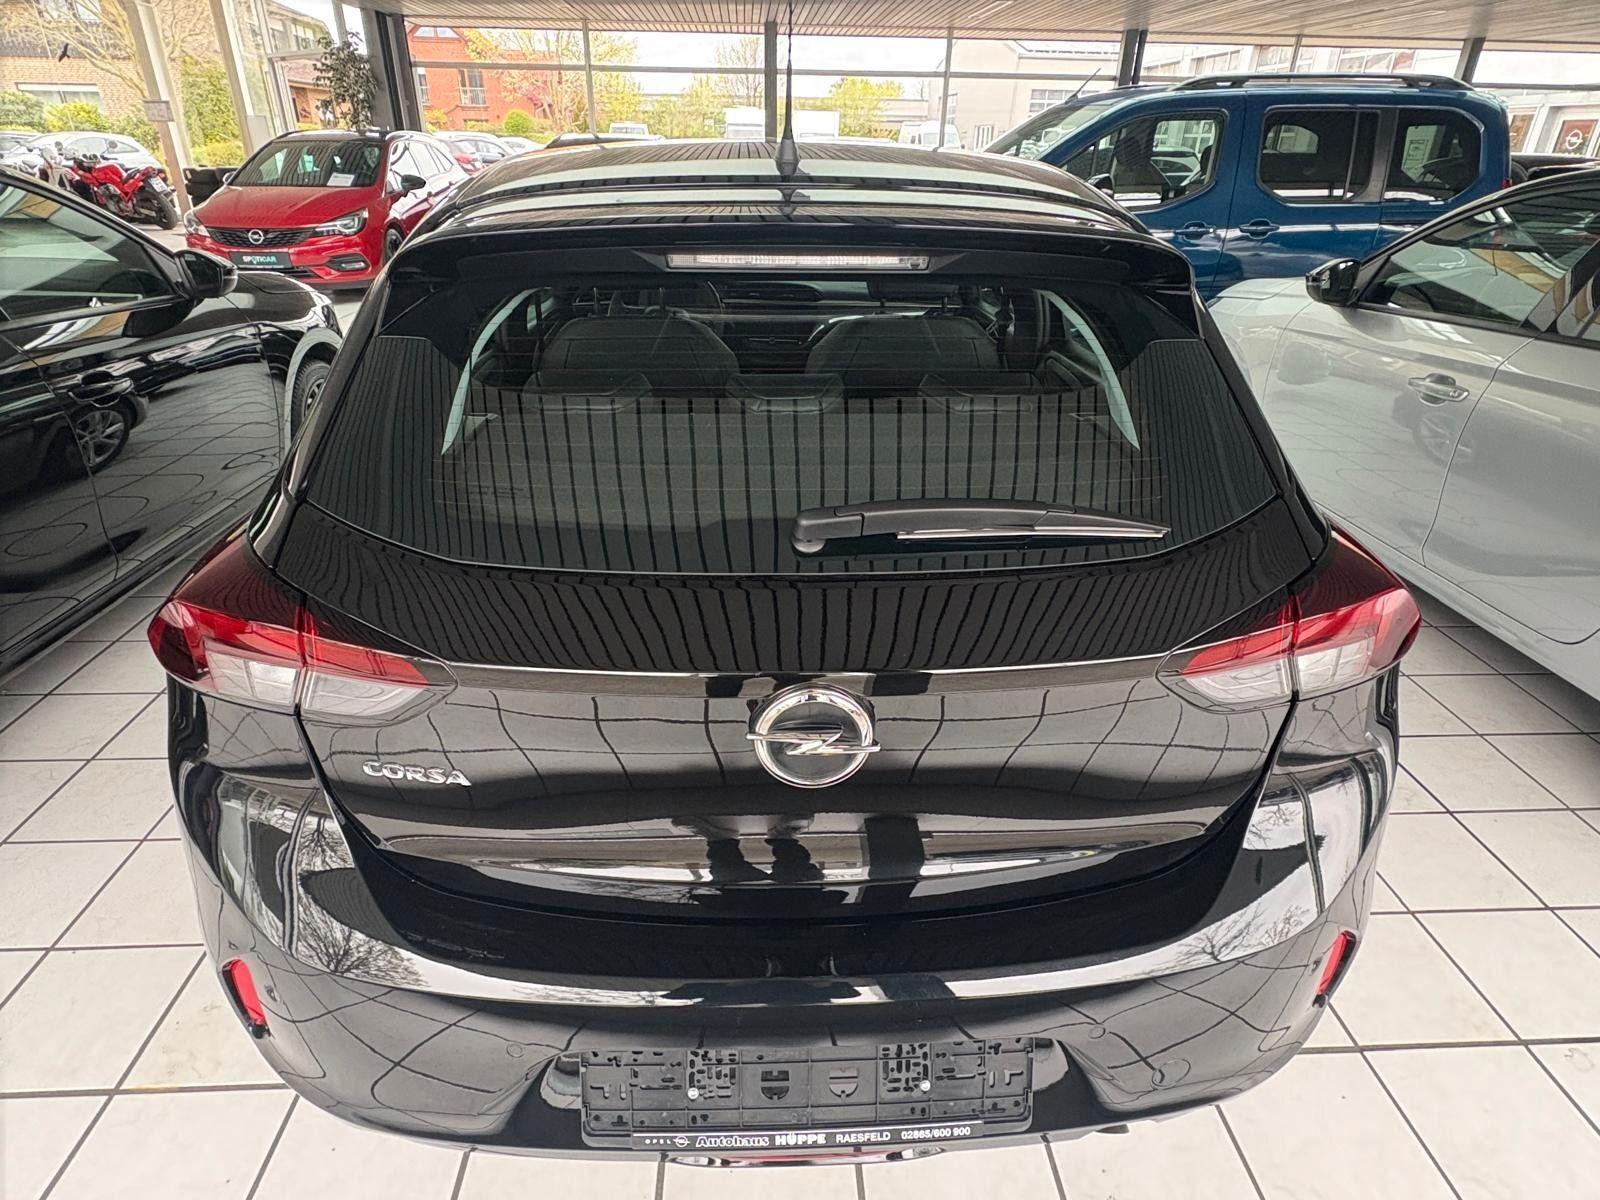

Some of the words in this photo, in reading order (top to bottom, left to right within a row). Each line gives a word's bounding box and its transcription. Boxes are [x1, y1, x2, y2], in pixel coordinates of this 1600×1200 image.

[242, 255, 277, 264] SPOTICAR
[362, 760, 471, 786] CORSA
[695, 1136, 770, 1148] Autohaus
[774, 1132, 827, 1146] HÜPPE
[835, 1131, 891, 1144] RAESFELD
[900, 1128, 951, 1140] 02865/600
[952, 1126, 971, 1136] 900
